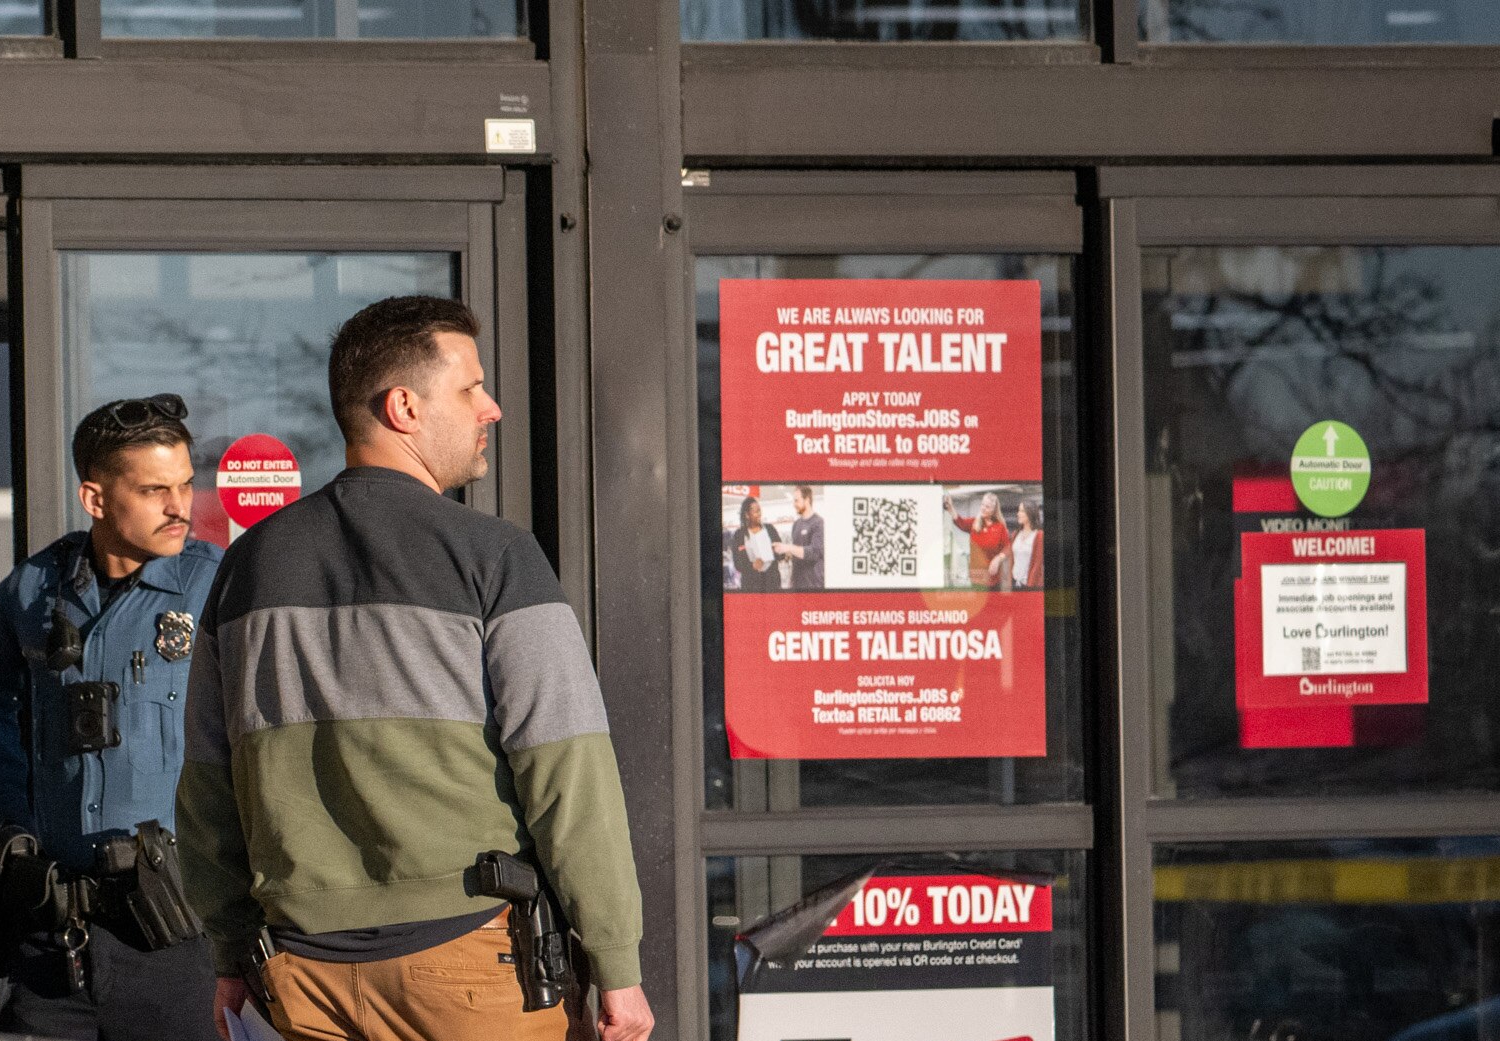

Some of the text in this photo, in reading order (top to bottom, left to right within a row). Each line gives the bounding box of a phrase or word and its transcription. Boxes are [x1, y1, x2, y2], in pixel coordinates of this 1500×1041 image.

[777, 308, 984, 325] WE ARE ALWAYS LOOKING FOR
[756, 332, 1007, 373] GREAT TALENT
[842, 392, 922, 406] APPLY TODAY
[786, 409, 979, 432] BurlingtonStores.JOBS OR
[794, 434, 970, 454] Text RETAIL to 60862
[227, 460, 293, 470] DO NOT ENTER
[1299, 459, 1363, 469] Automatic Door
[227, 475, 294, 484] Automatic Door
[1310, 478, 1352, 491] CAUTION
[238, 492, 284, 507] CAUTION
[1260, 518, 1302, 533] VIDEO
[1292, 536, 1375, 557] WELCOME!
[801, 609, 968, 626] SIEMPRE ESTAMOS BUSCANDO
[1283, 626, 1312, 639] Love
[768, 629, 1003, 662] GENTE TALENTOSA
[857, 675, 915, 688] SOLICITA HOY
[1300, 677, 1374, 698] Burlington
[813, 688, 948, 708] BurlingtonStores.JOBS
[811, 706, 962, 723] Textea RETAIL al 60862
[852, 884, 1036, 927] 10% TODAY
[817, 943, 859, 955] purchase
[860, 941, 880, 953] with
[880, 942, 901, 954] your
[902, 942, 921, 952] new
[922, 940, 968, 953] Burlington
[969, 939, 997, 950] Credit
[794, 959, 814, 971] your
[815, 957, 852, 969] account
[852, 956, 861, 967] is
[861, 956, 897, 969] opened
[898, 956, 912, 967] via
[912, 954, 928, 966] QR
[929, 955, 952, 966] code
[953, 955, 964, 965] or
[964, 955, 975, 965] at
[975, 953, 1019, 965] checkout.
